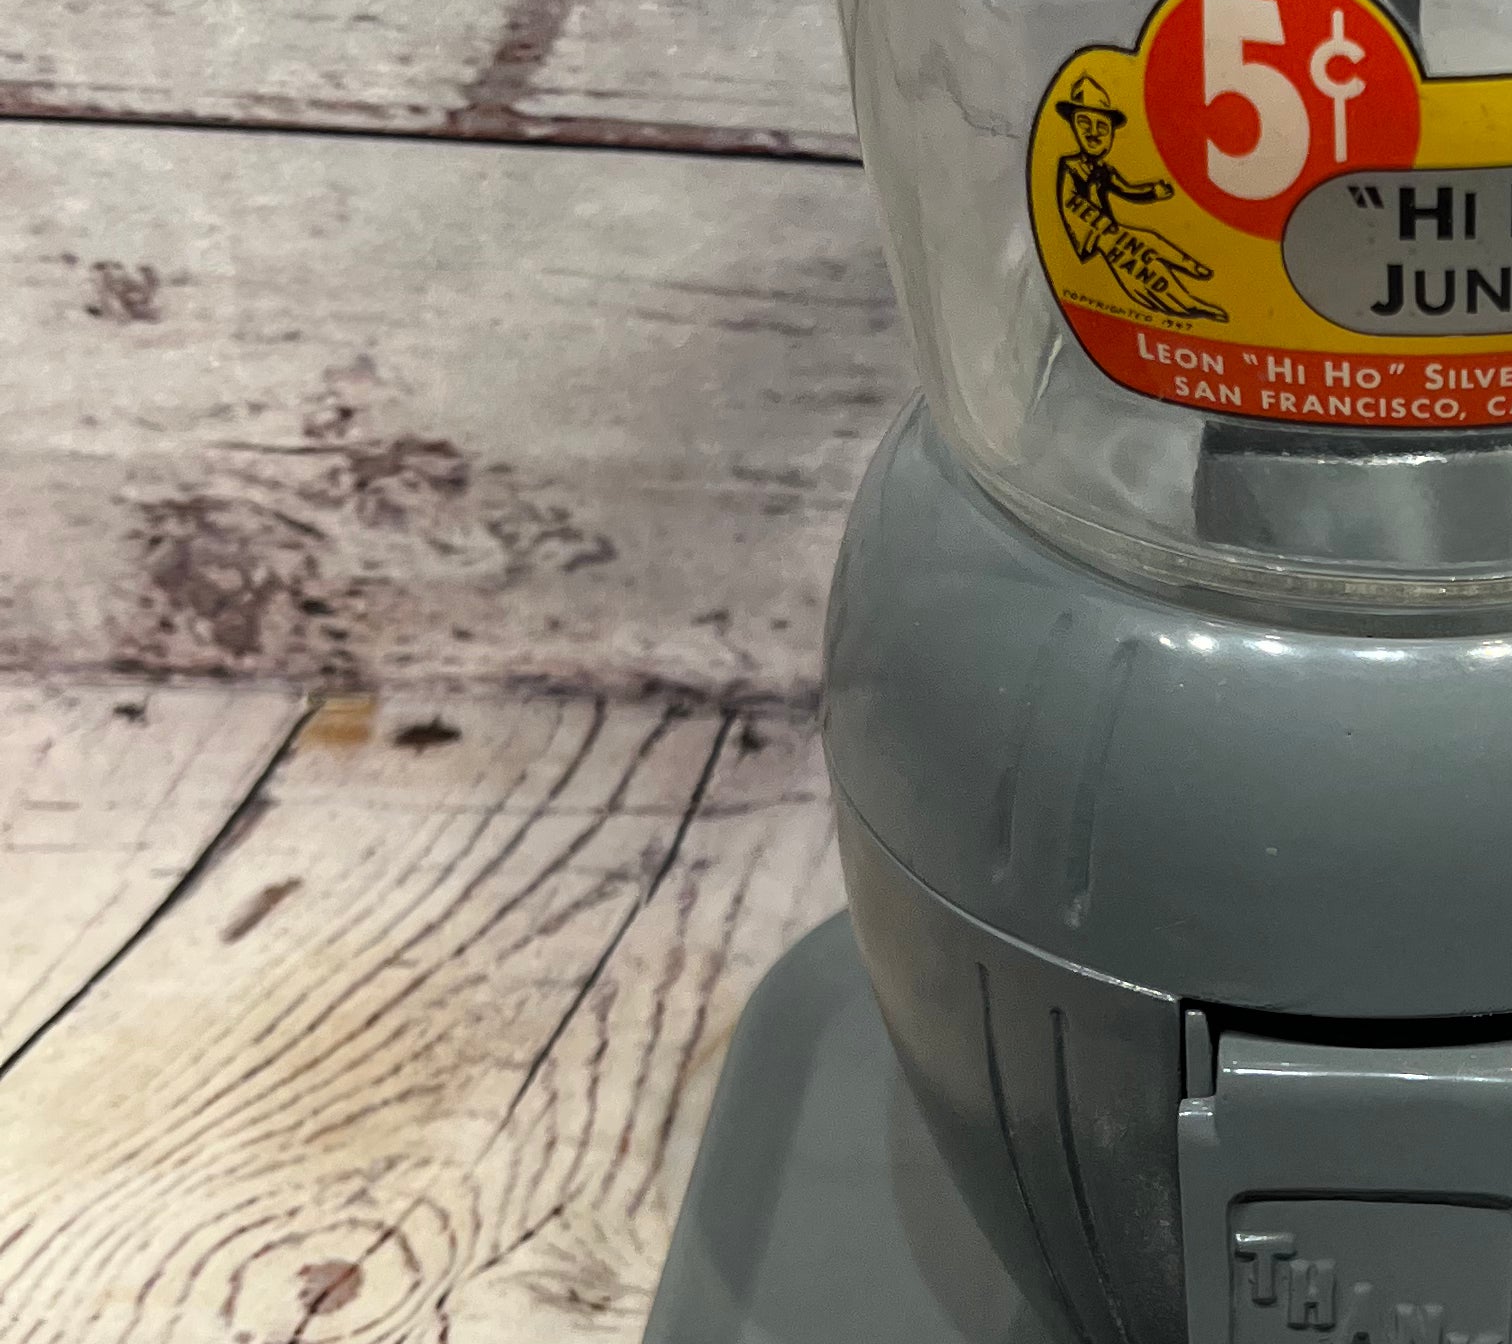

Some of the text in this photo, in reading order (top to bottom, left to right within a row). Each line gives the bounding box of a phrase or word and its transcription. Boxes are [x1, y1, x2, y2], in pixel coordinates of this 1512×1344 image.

[1066, 193, 1159, 266] HELPING
[1348, 185, 1476, 240] "HI
[1106, 247, 1170, 293] HAND
[1173, 376, 1242, 406] SAN
[1260, 390, 1467, 421] FRANCISCO,
